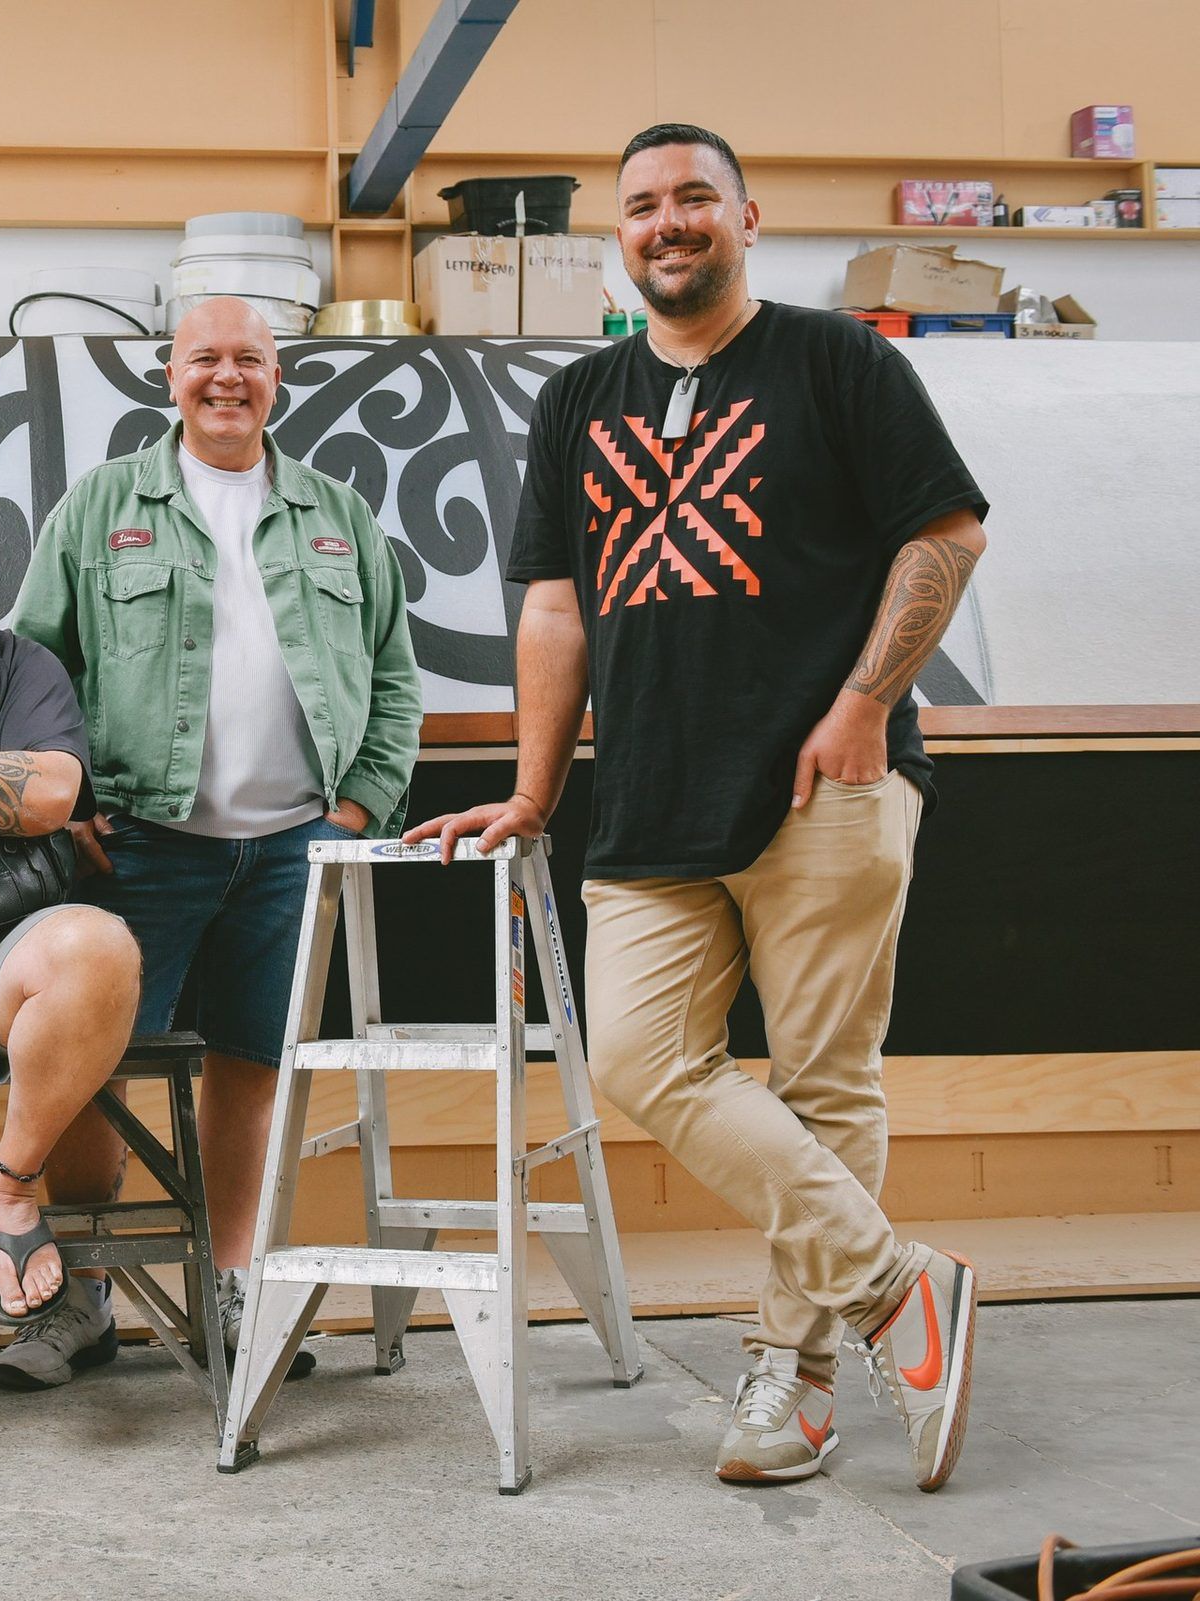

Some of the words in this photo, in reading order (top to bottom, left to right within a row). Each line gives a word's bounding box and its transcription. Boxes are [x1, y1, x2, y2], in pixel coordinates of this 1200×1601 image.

[117, 533, 142, 544] Liam
[385, 845, 430, 853] WERNER
[549, 920, 569, 999] WERNER
